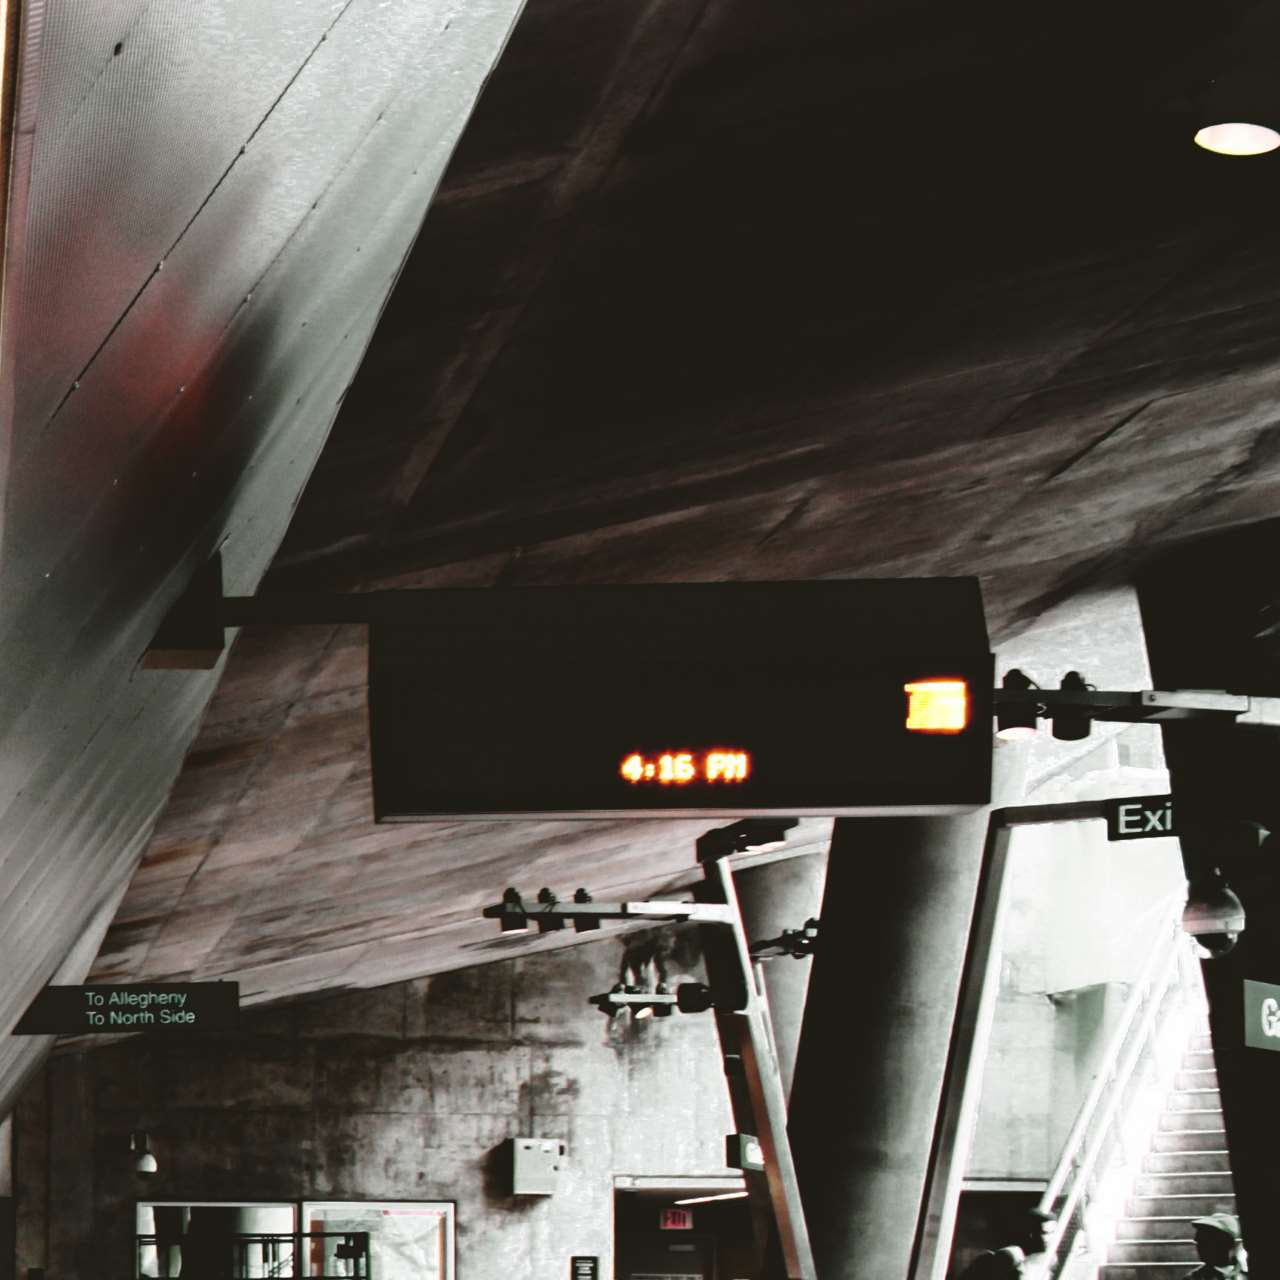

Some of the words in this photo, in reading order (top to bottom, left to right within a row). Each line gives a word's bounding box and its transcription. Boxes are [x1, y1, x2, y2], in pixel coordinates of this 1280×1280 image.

[621, 753, 696, 783] 4:16
[705, 751, 749, 783] PM
[1118, 801, 1172, 834] Exi
[85, 992, 105, 1006] To
[108, 991, 187, 1008] Allegheny
[85, 1011, 105, 1025] To
[109, 1010, 155, 1025] North
[160, 1009, 196, 1024] Side
[1261, 997, 1280, 1038] G
